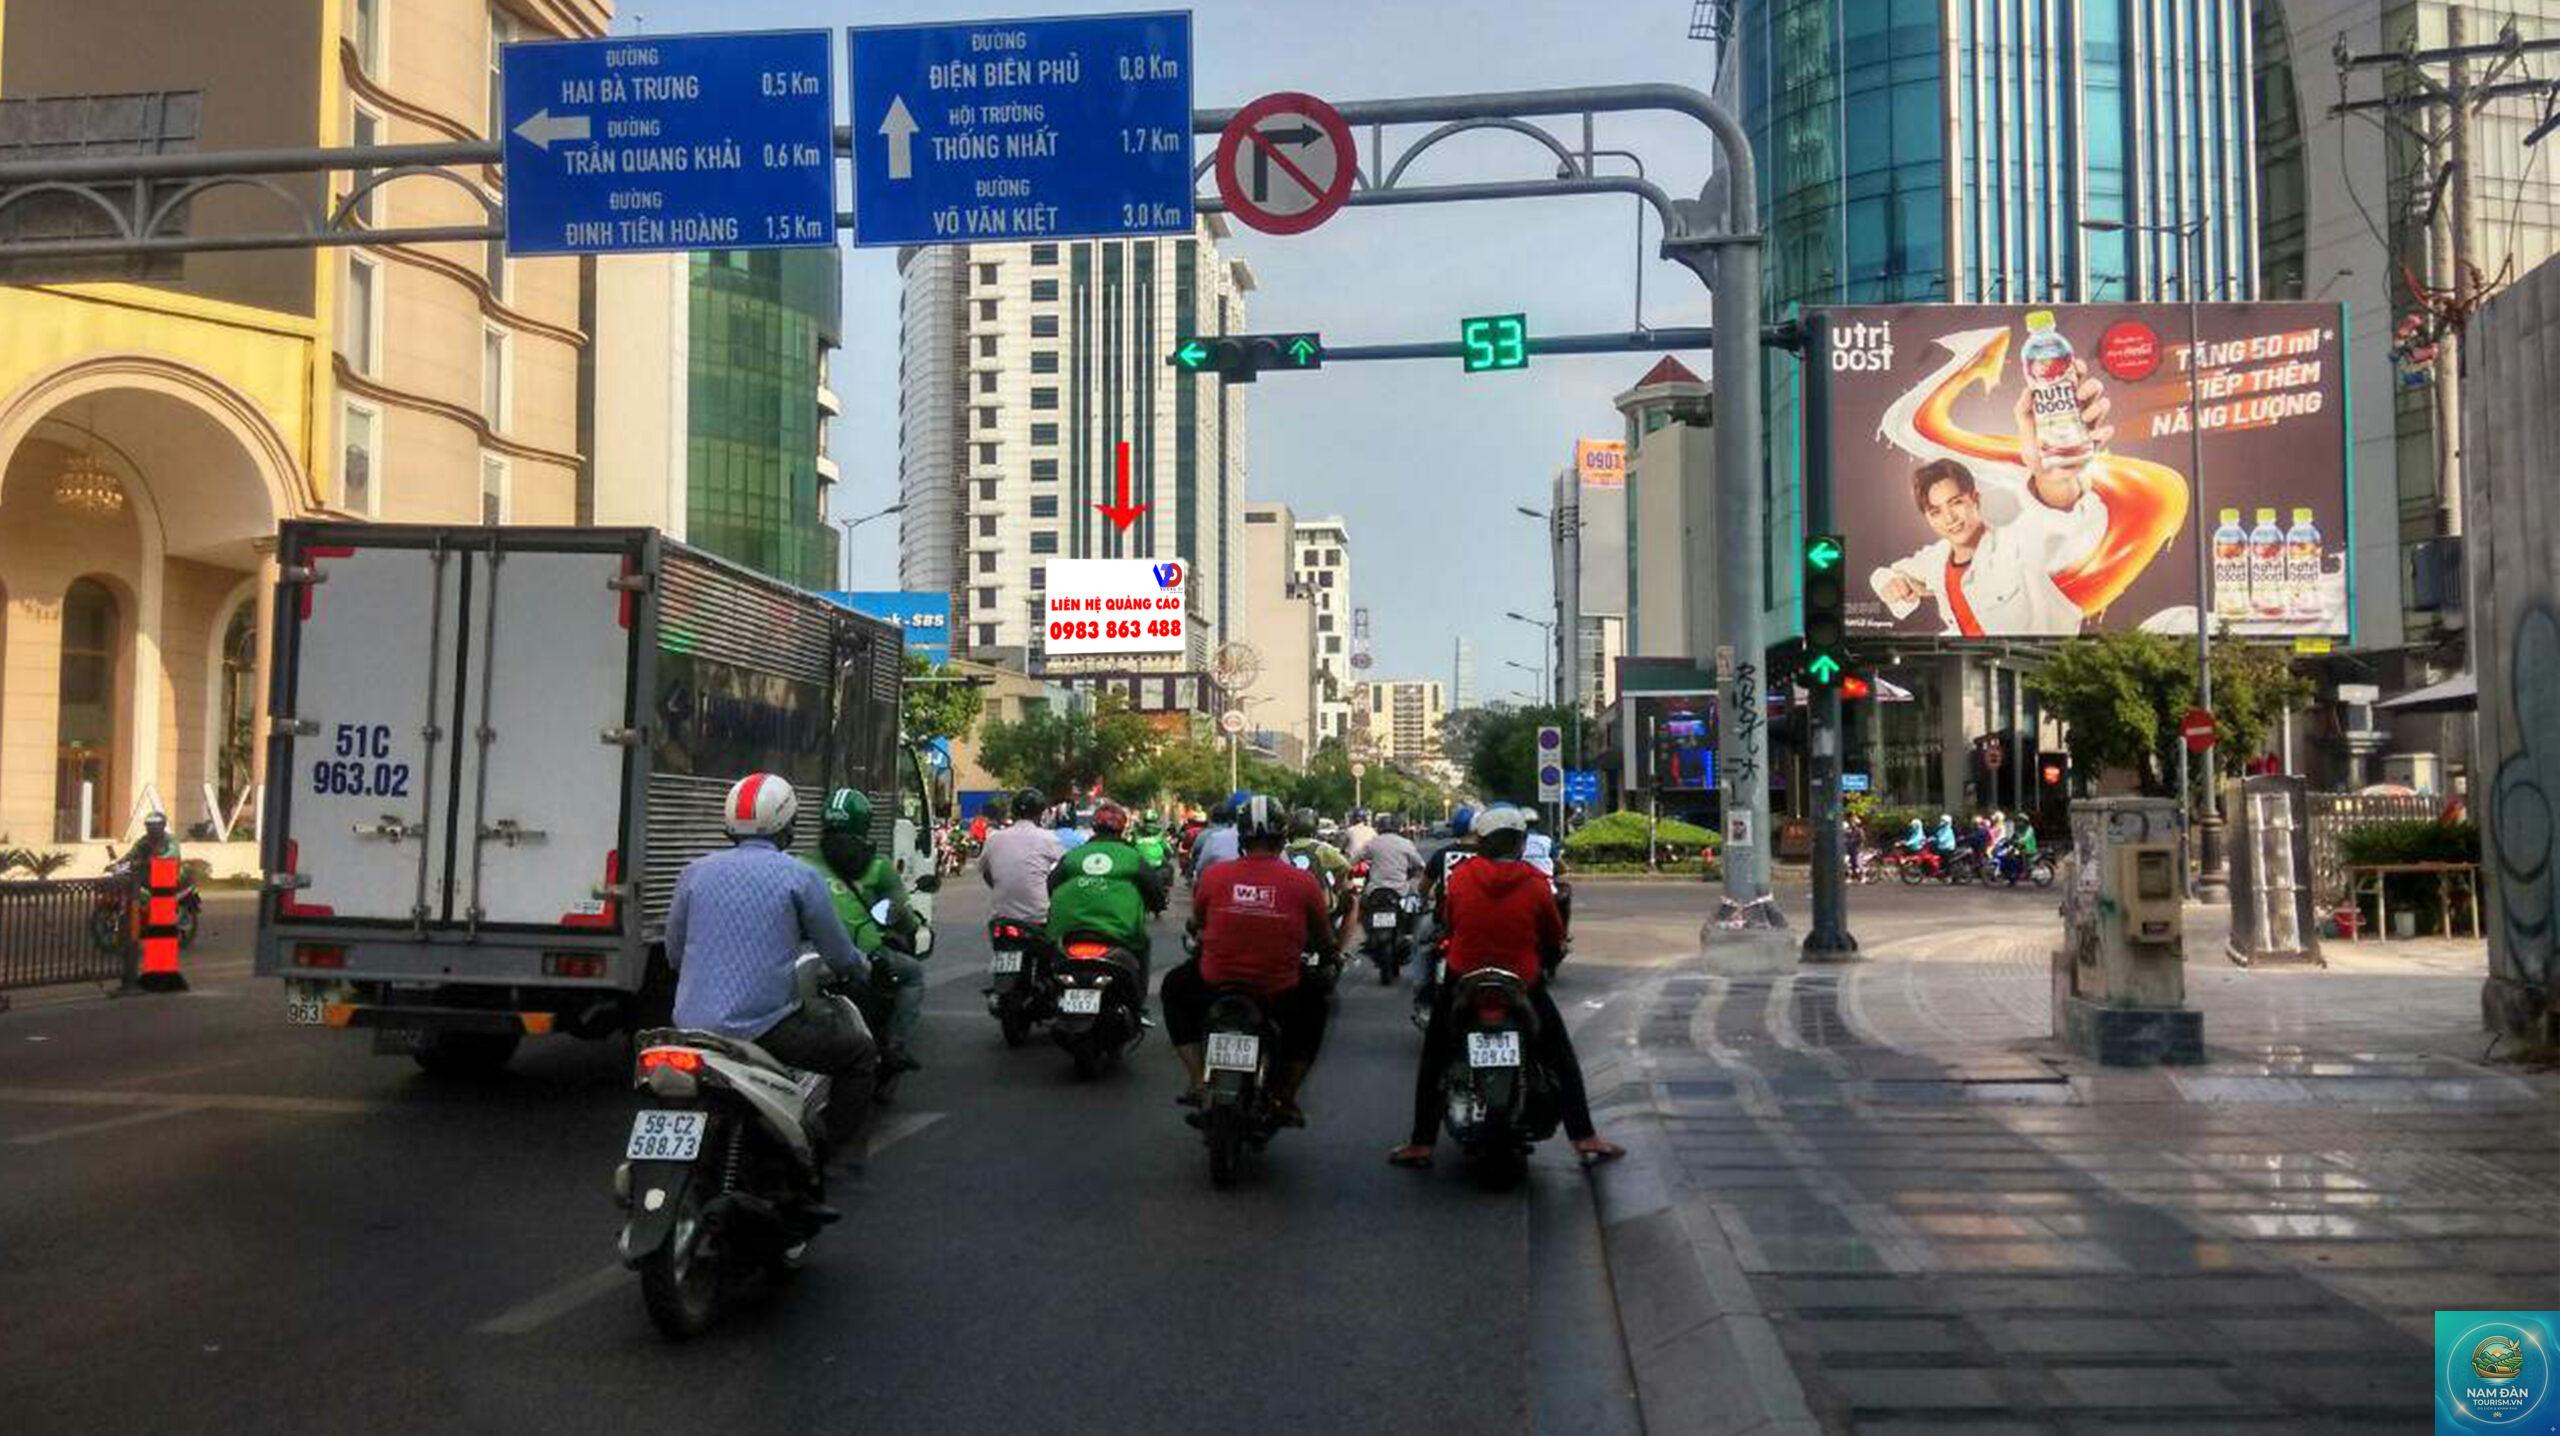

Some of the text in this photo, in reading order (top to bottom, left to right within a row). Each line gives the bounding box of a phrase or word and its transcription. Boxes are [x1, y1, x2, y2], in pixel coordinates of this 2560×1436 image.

[972, 30, 1026, 51] ĐƯỜNG
[606, 48, 659, 67] ĐƯỜNG
[929, 60, 977, 92] ĐIỆN
[984, 56, 1031, 87] BIÊN
[1038, 52, 1080, 84] PHỦ
[1150, 54, 1178, 79] Km
[561, 79, 594, 104] HAI
[602, 73, 627, 102] BÀ
[631, 75, 700, 100] TRƯNG
[792, 71, 819, 95] Km
[607, 119, 661, 138] ĐƯỜNG
[949, 101, 1045, 128] HỘI TRƯỜNG
[564, 141, 616, 175] TRẦN
[622, 148, 687, 173] QUANG
[694, 138, 741, 169] KHẢI
[793, 143, 820, 167] Km
[932, 129, 999, 162] THỐNG
[1006, 125, 1059, 159] NHẤT
[1152, 127, 1179, 152] Km
[609, 190, 662, 211] ĐƯỜNG
[976, 177, 1030, 198] ĐƯỜNG
[566, 222, 613, 246] ĐINH
[619, 216, 664, 244] TIÊN
[671, 212, 738, 242] HOÀNG
[795, 215, 822, 239] Km
[933, 205, 960, 236] VÕ
[965, 205, 1006, 234] VĂN
[1013, 202, 1059, 236] KIỆT
[1153, 202, 1180, 227] Km
[1466, 320, 1522, 367] 53
[2250, 333, 2281, 360] 50
[2249, 361, 2321, 391] THÊM
[2151, 391, 2323, 437] NĂNG LƯỢNG
[336, 724, 391, 758] 51C
[313, 761, 409, 798] 963.02
[644, 1115, 696, 1135] 59-C2
